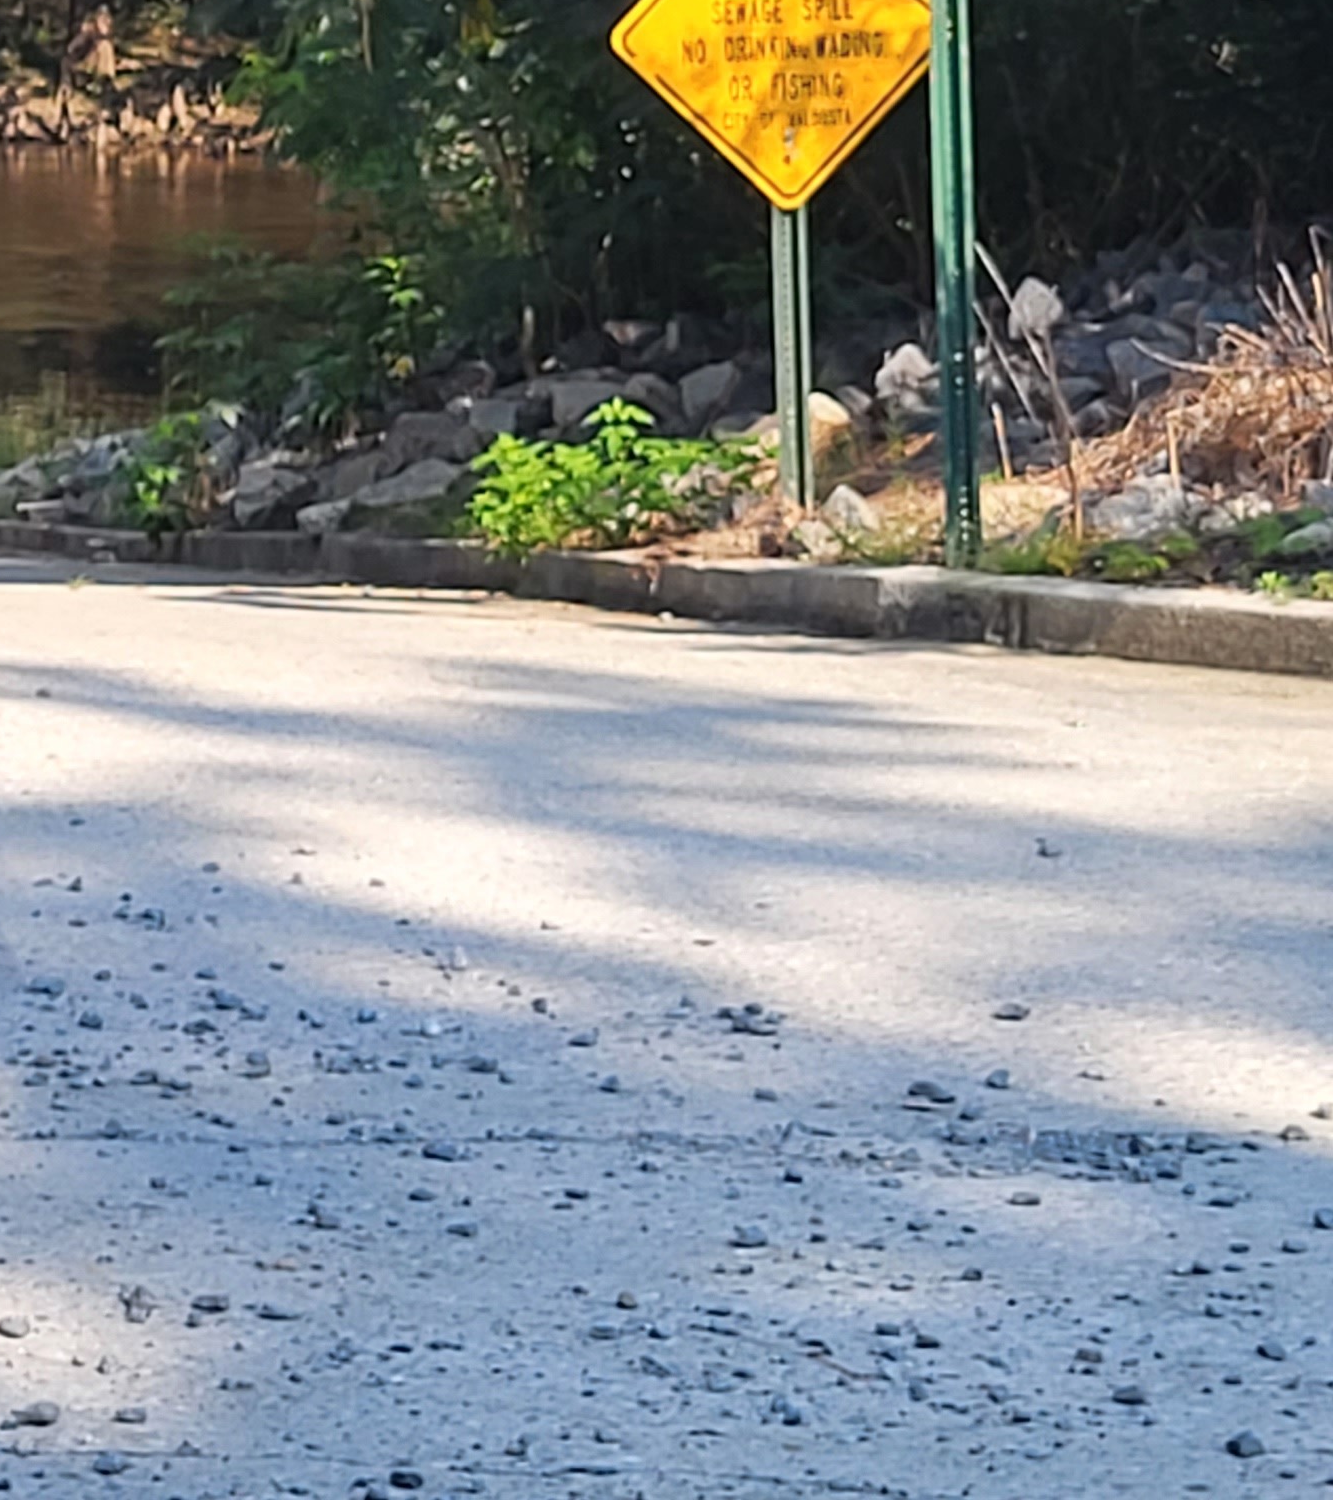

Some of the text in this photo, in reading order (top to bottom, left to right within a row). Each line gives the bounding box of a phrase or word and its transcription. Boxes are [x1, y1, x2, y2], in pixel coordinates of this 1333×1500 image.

[682, 38, 707, 64] NO
[729, 71, 844, 100] OR FISHING
